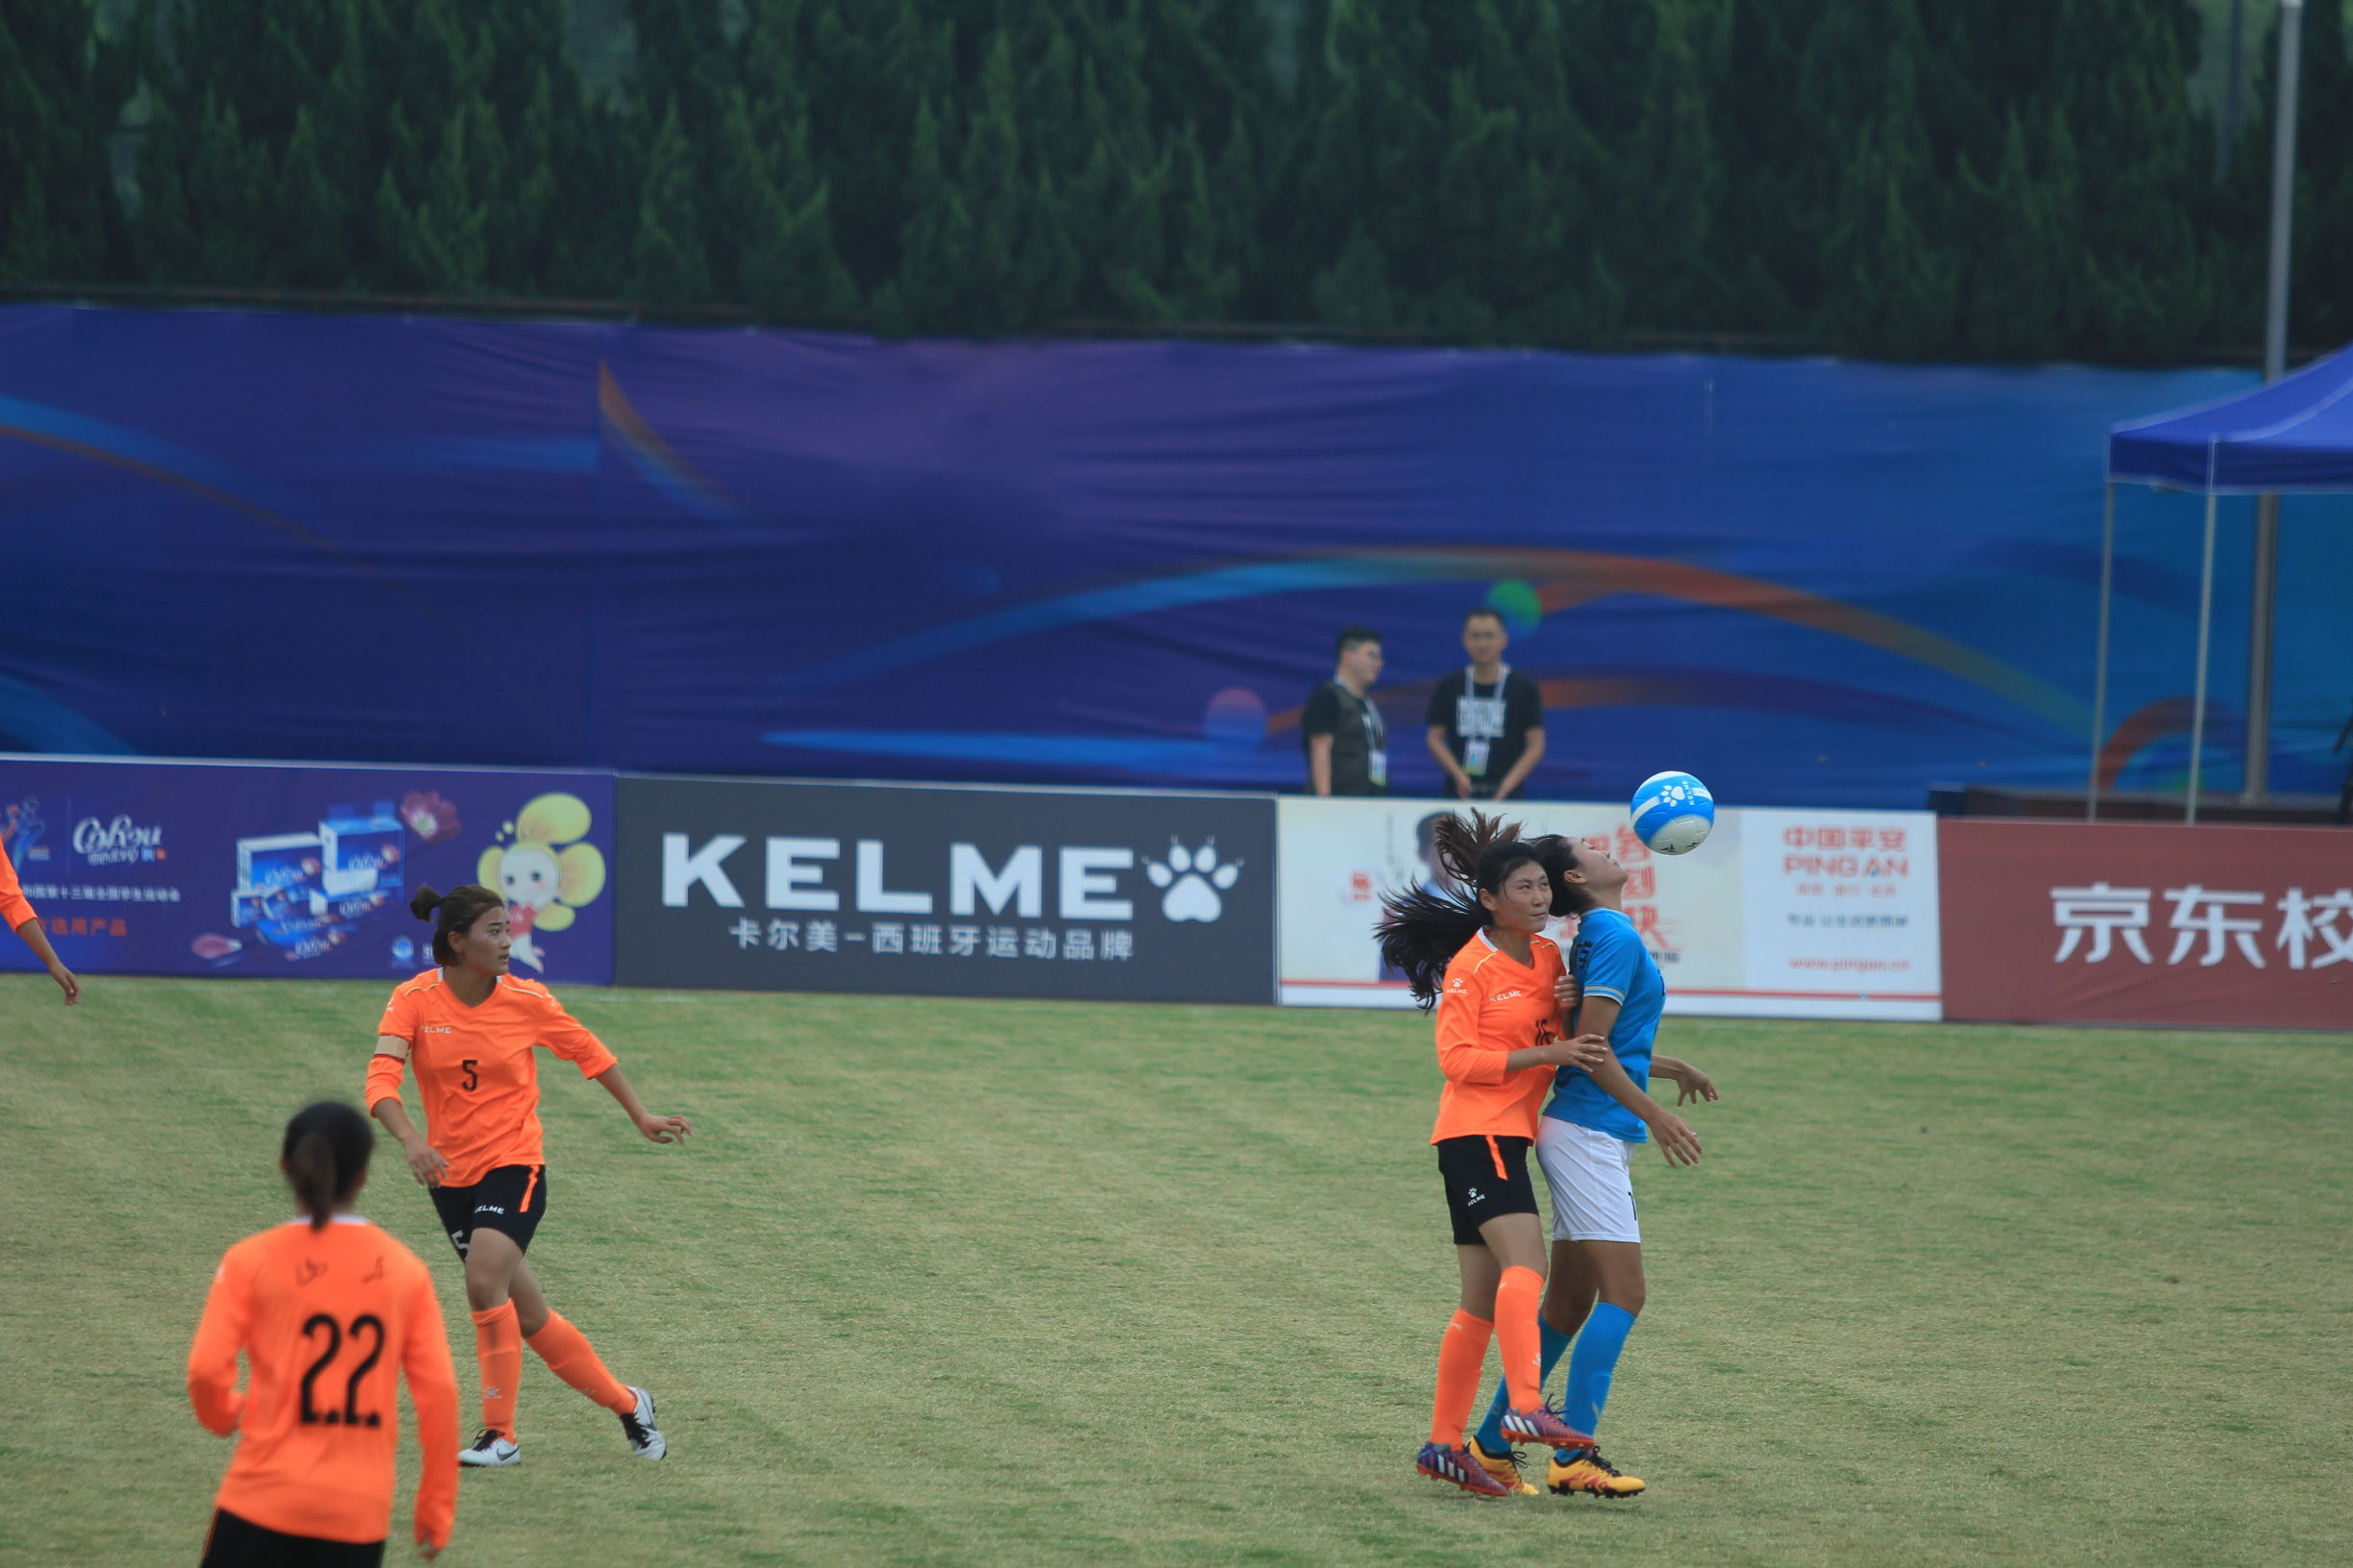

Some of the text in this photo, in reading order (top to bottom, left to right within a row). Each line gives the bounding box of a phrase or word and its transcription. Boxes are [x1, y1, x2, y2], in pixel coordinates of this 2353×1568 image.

[1783, 826, 1907, 851] 中国平安
[1783, 855, 1909, 878] PING AN
[661, 831, 1135, 920] KELME
[2048, 881, 2353, 970] 京东校
[461, 1059, 478, 1092] 5
[298, 1313, 385, 1428] 22
